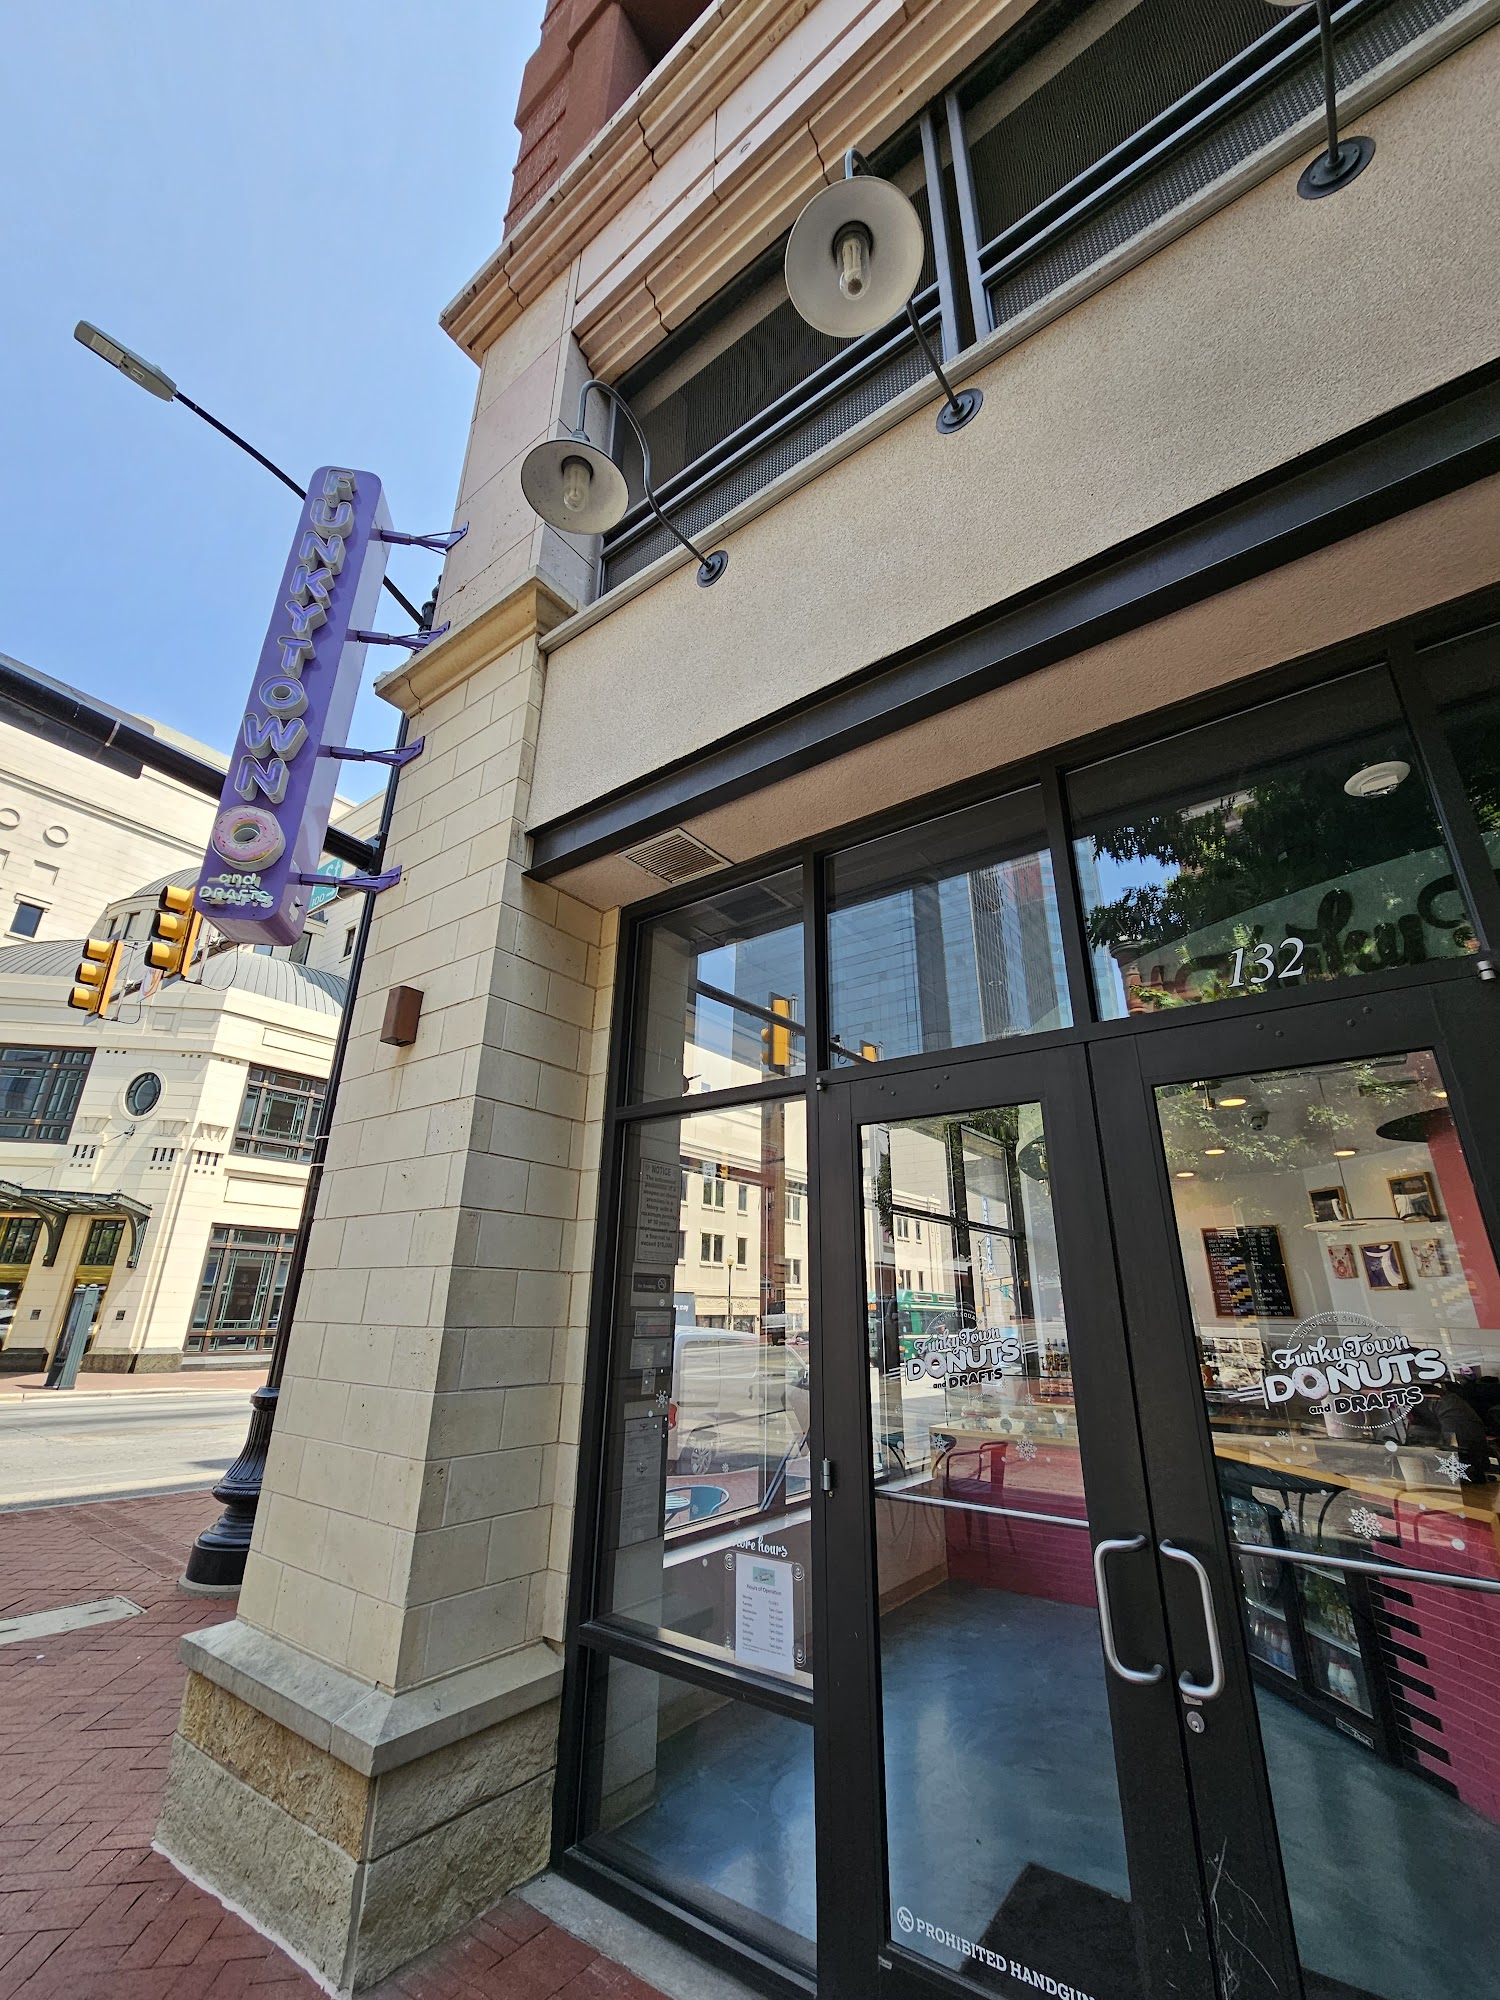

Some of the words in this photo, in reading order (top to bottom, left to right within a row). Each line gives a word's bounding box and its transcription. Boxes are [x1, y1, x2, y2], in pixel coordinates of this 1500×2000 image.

[234, 468, 357, 805] FUNKYTOWN
[311, 892, 325, 907] 100
[1227, 937, 1304, 988] 132
[651, 1165, 671, 1176] NOTICE
[906, 1338, 1022, 1381] DONUTS
[1264, 1349, 1448, 1404] DONUTS
[933, 1381, 947, 1389] and
[949, 1368, 1003, 1389] DRAFTS
[1309, 1403, 1331, 1415] and
[1334, 1386, 1424, 1415] DRAFTS
[758, 1535, 788, 1558] hours
[916, 1917, 1008, 1973] PROHIBITED
